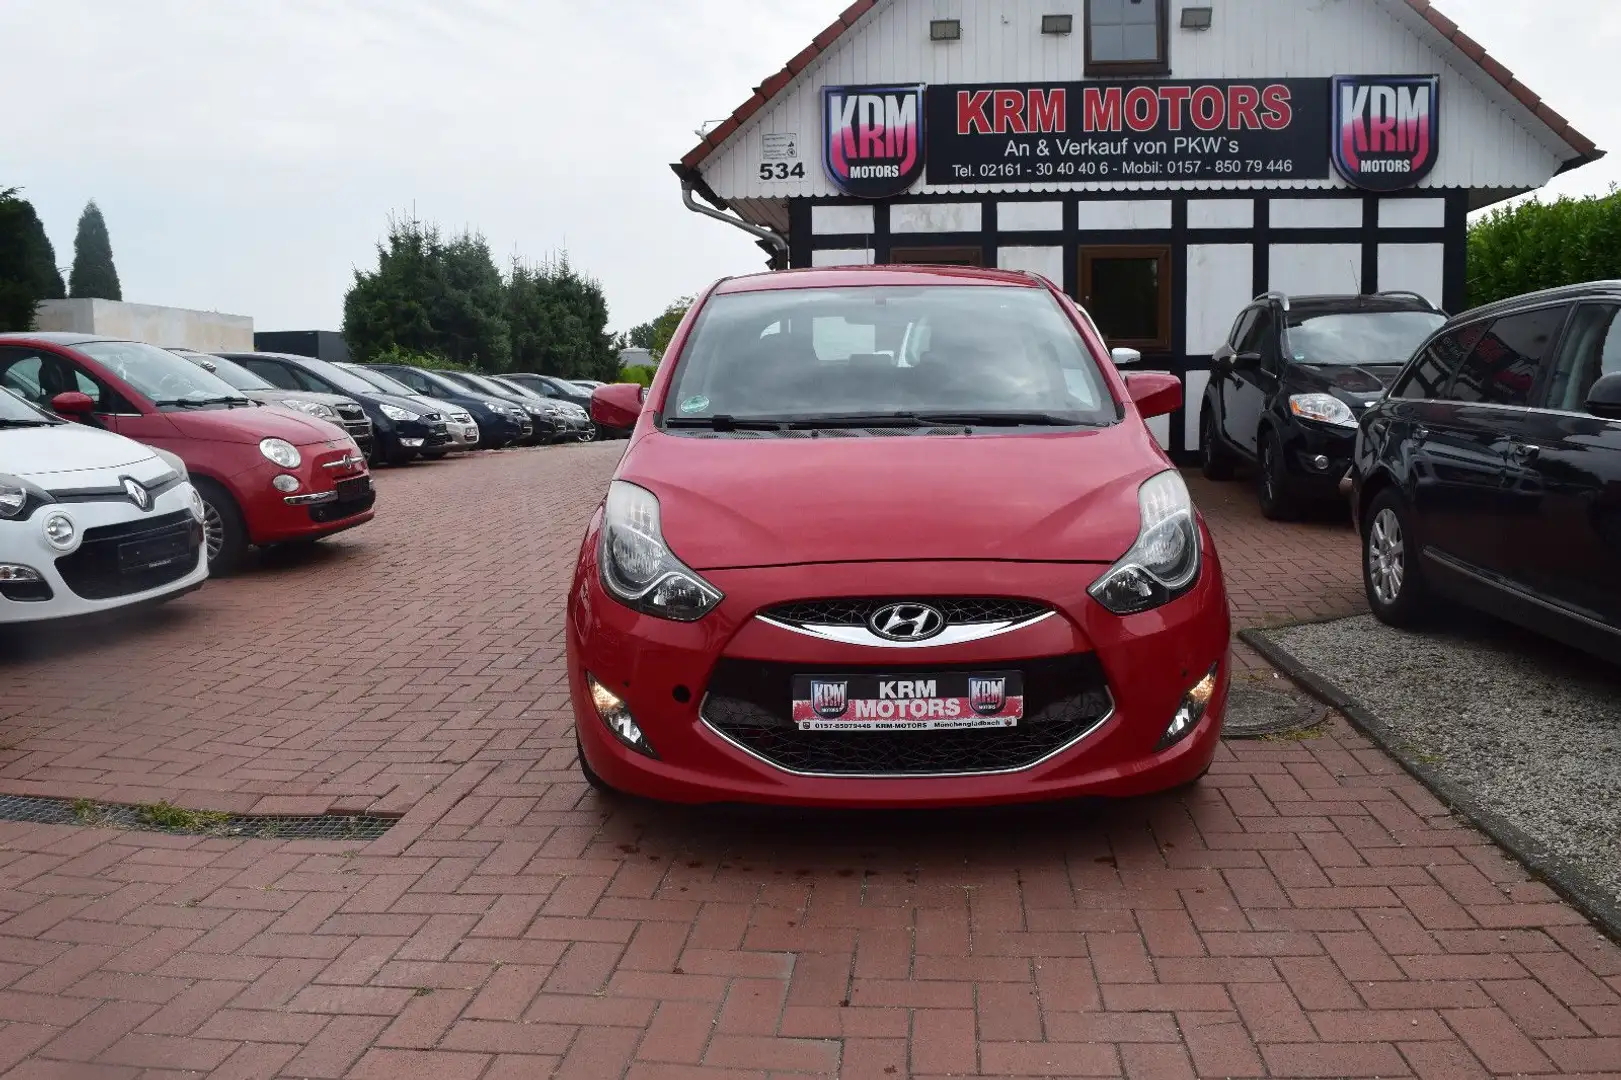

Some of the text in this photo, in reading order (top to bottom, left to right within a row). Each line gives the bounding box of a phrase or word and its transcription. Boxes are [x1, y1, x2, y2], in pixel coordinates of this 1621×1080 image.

[957, 84, 1293, 135] KRM MOTORS
[1342, 85, 1429, 154] KRM
[830, 93, 917, 161] KRM
[1003, 139, 1030, 157] An
[1036, 138, 1050, 157] &
[1056, 137, 1129, 156] Verkauf
[1133, 141, 1167, 155] von
[759, 162, 804, 181] 534
[849, 164, 900, 179] MOTORS
[951, 164, 975, 178] Tel.
[979, 163, 1021, 177] 02161
[1035, 162, 1053, 176] 30
[1056, 162, 1075, 175] 40
[1077, 162, 1096, 175] 40
[1099, 161, 1109, 175] 6
[1122, 161, 1163, 174] Mobil:
[1167, 160, 1202, 174] 0157
[1214, 159, 1241, 173] 850
[1245, 159, 1263, 173] 79
[1266, 159, 1293, 173] 446
[1360, 159, 1411, 173] MOTORS
[814, 683, 845, 707] KRM
[879, 680, 937, 699] KRM
[971, 680, 1003, 704] KRM
[855, 698, 961, 718] MOTORS
